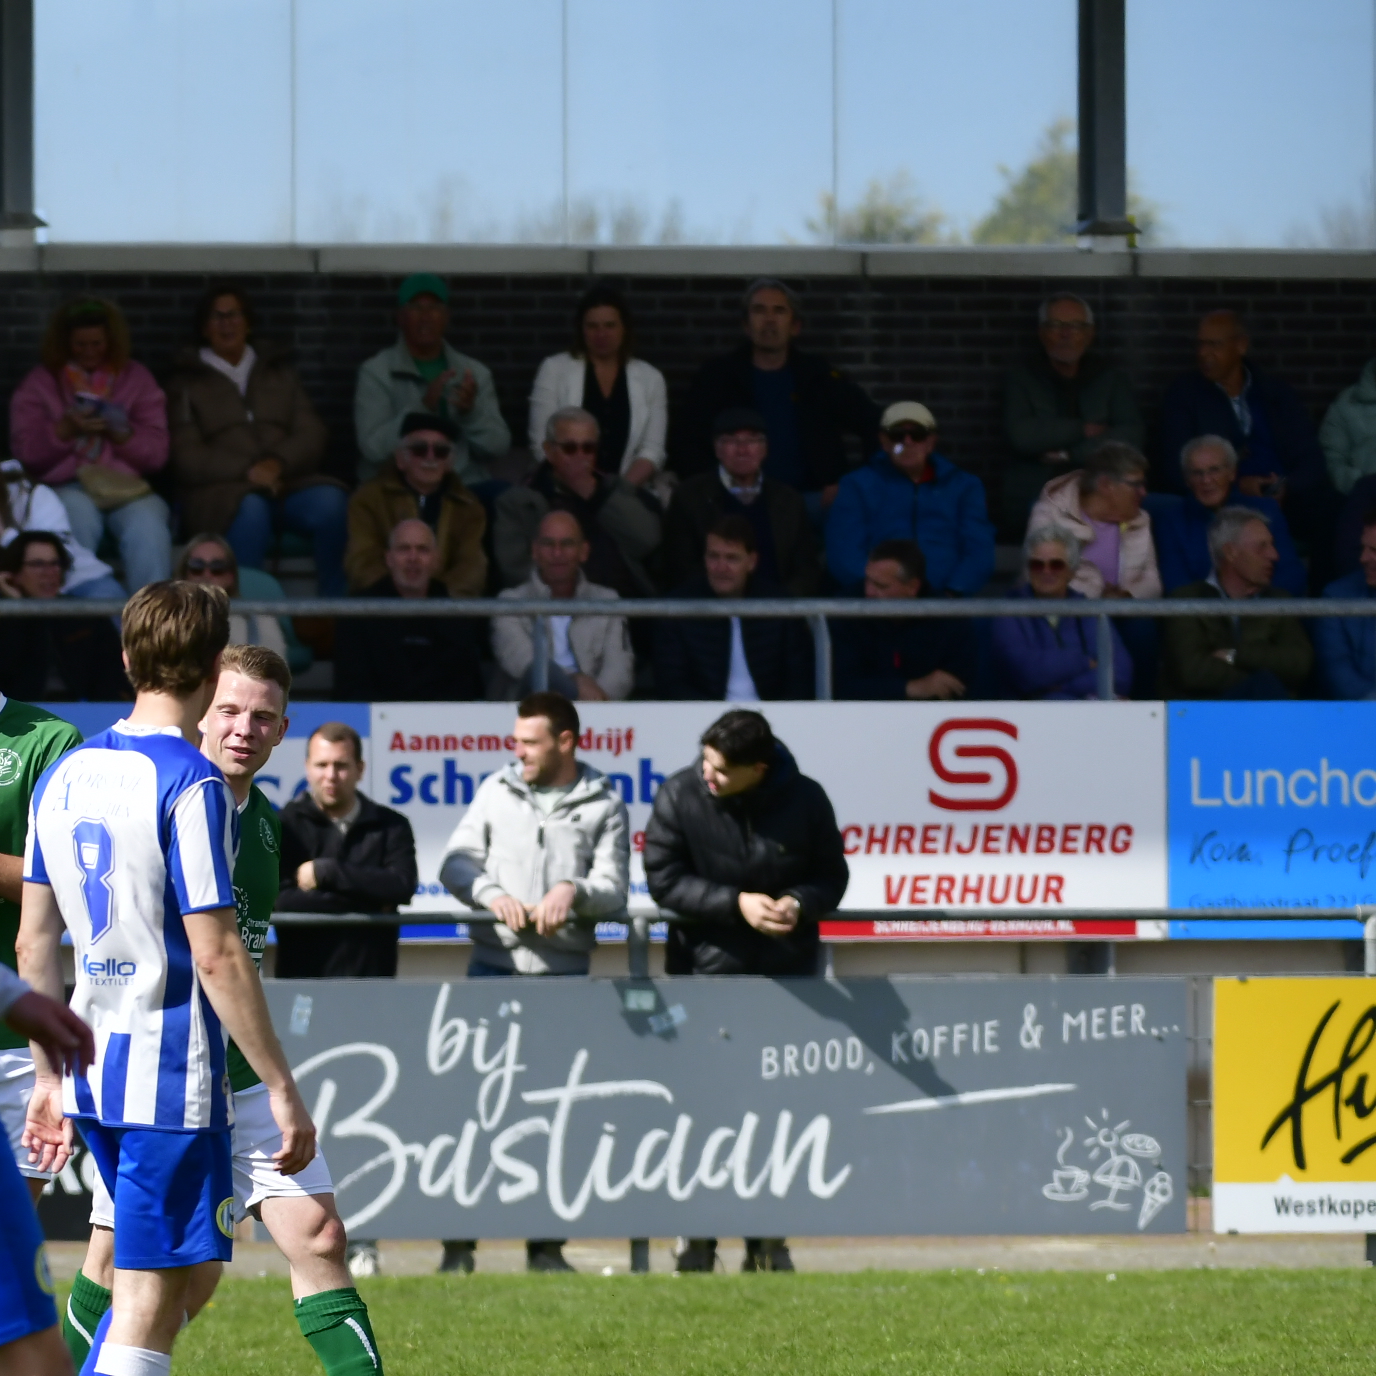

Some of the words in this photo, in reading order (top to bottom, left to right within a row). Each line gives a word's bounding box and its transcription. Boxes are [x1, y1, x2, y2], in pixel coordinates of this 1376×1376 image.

[842, 823, 1136, 856] CHREIJENBERG
[883, 874, 1066, 906] VERHUUR
[426, 982, 527, 1130] bij
[760, 1036, 876, 1080] BROOD,
[891, 1018, 1002, 1065] KOFFIE
[1019, 1002, 1044, 1051] &
[293, 1042, 853, 1232] Bastiaan
